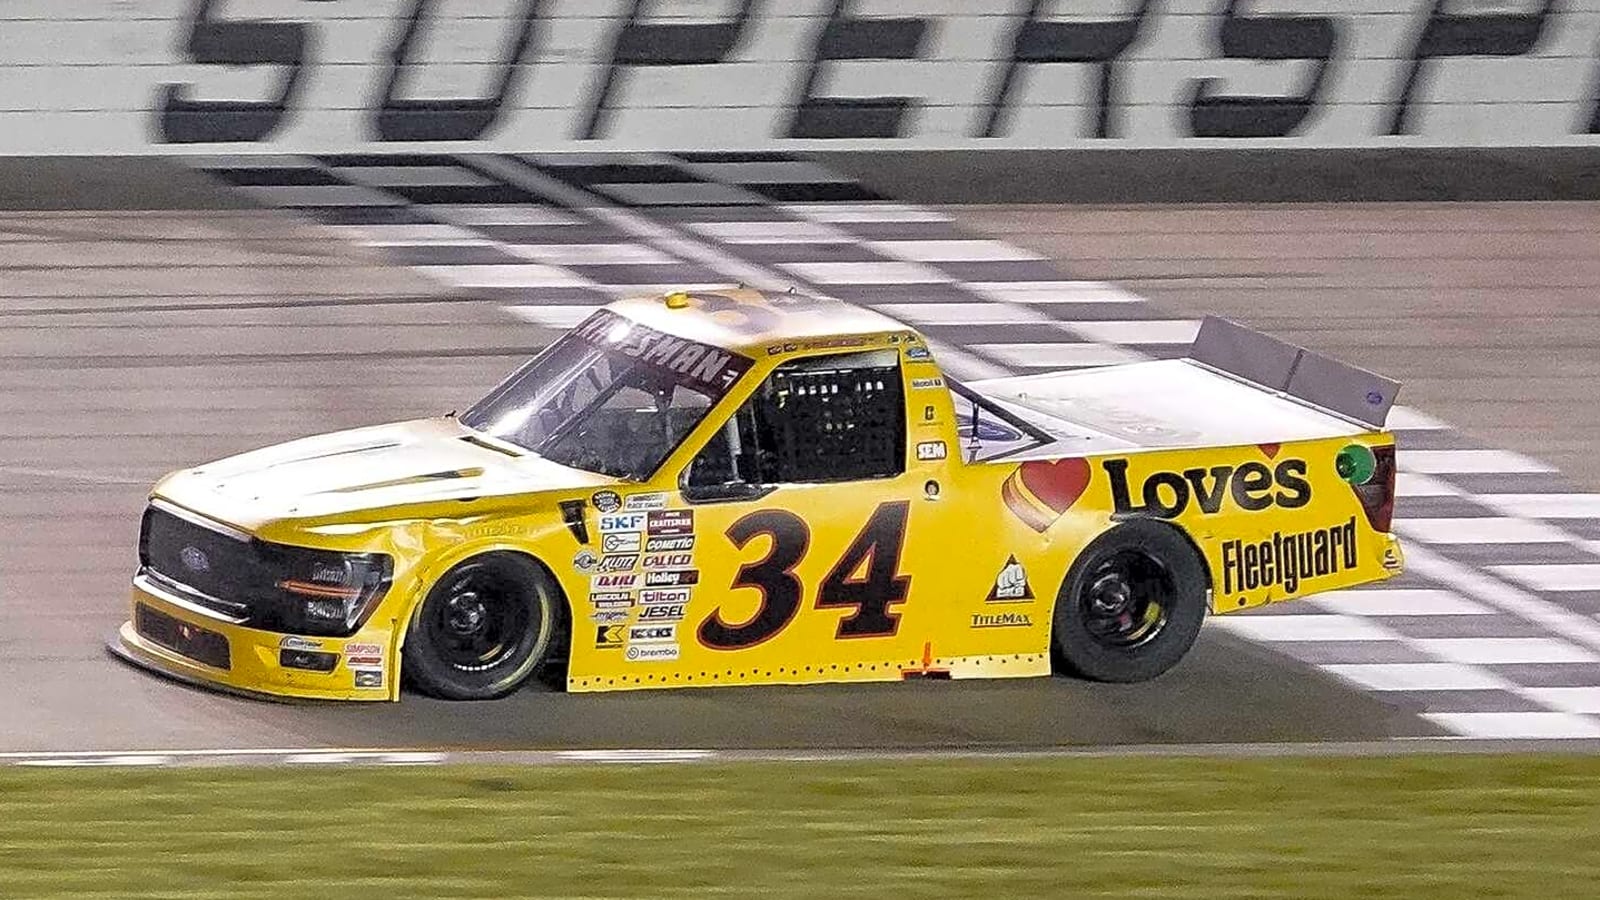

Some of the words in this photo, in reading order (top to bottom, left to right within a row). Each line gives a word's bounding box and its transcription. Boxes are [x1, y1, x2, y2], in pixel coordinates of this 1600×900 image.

[150, 0, 1600, 142] SUPERSP
[919, 443, 946, 458] SEM
[601, 515, 644, 530] SKF
[647, 537, 694, 551] COMETIC
[643, 555, 692, 567] CALICO
[1222, 516, 1357, 595] Fleetguard
[647, 572, 680, 585] Holley
[696, 500, 912, 651] 34
[643, 592, 687, 602] tilton
[639, 606, 684, 618] JESEL
[346, 645, 381, 654] SIMPSON
[640, 648, 677, 656] brembo
